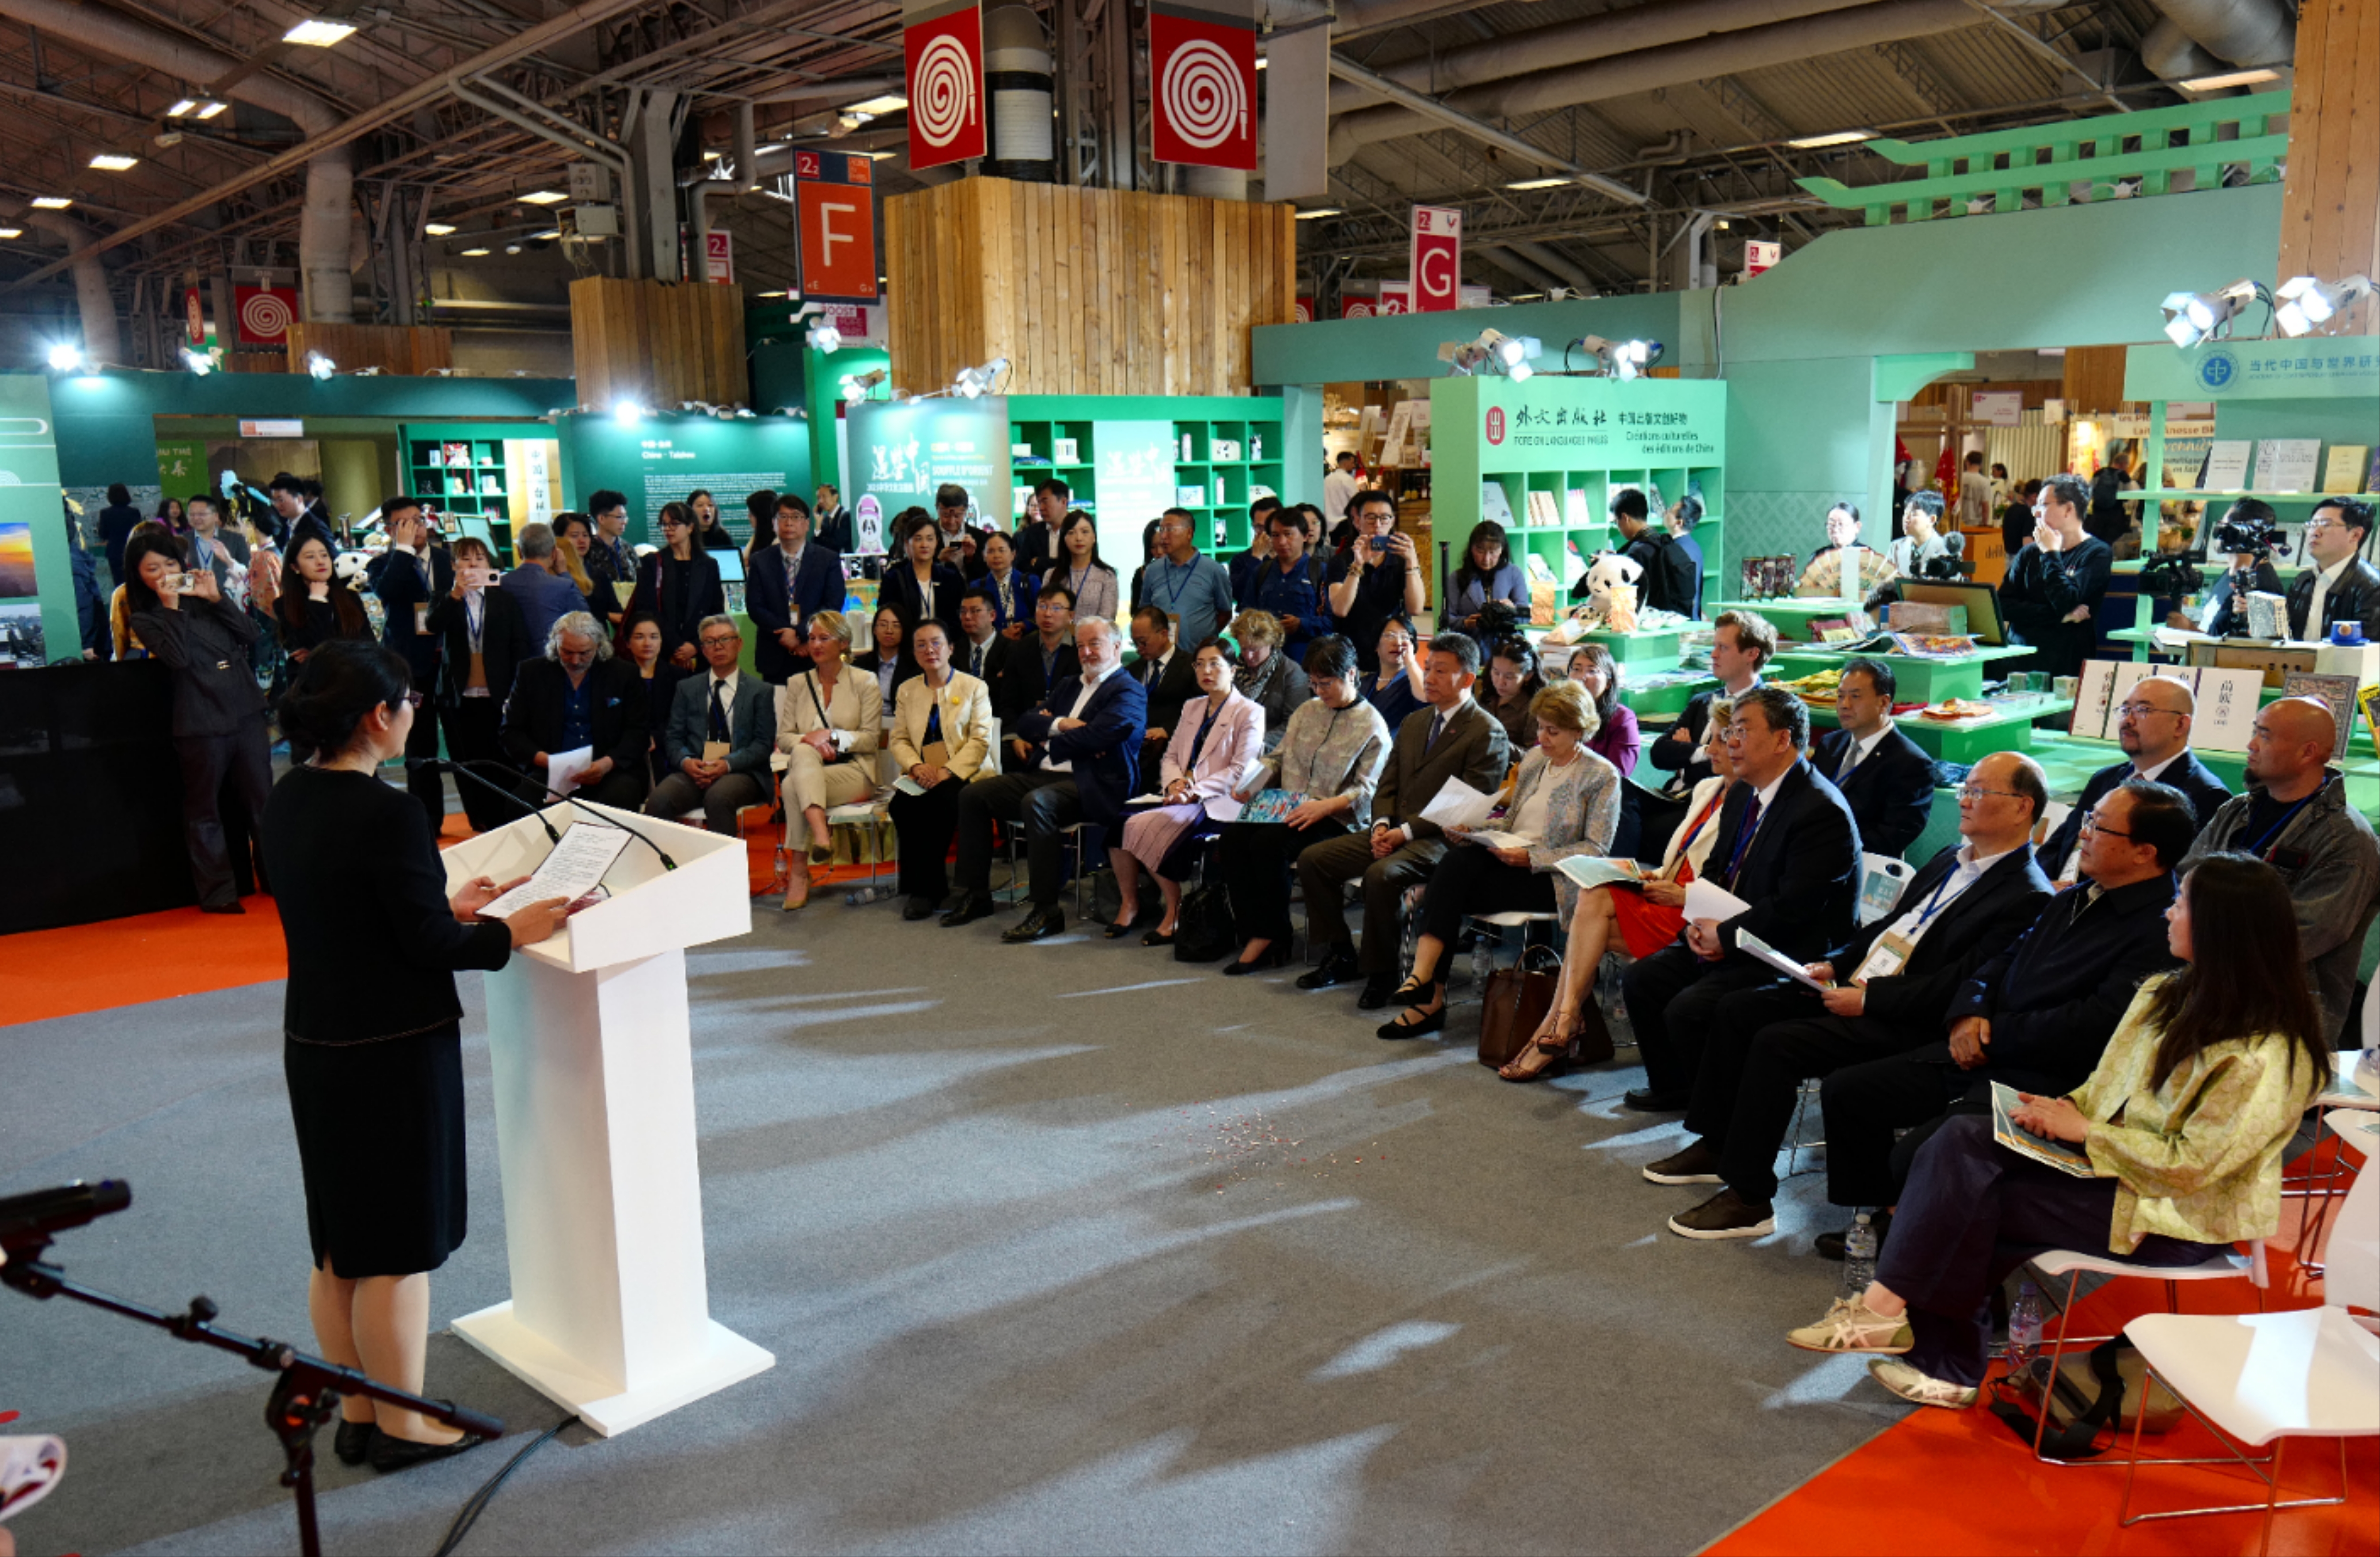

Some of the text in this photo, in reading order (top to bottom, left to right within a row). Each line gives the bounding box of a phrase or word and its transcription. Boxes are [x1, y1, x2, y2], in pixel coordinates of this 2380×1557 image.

[821, 203, 855, 267] F
[1421, 247, 1451, 297] G
[813, 281, 819, 290] E
[860, 284, 867, 292] G
[1516, 404, 1607, 428] 外文出版社
